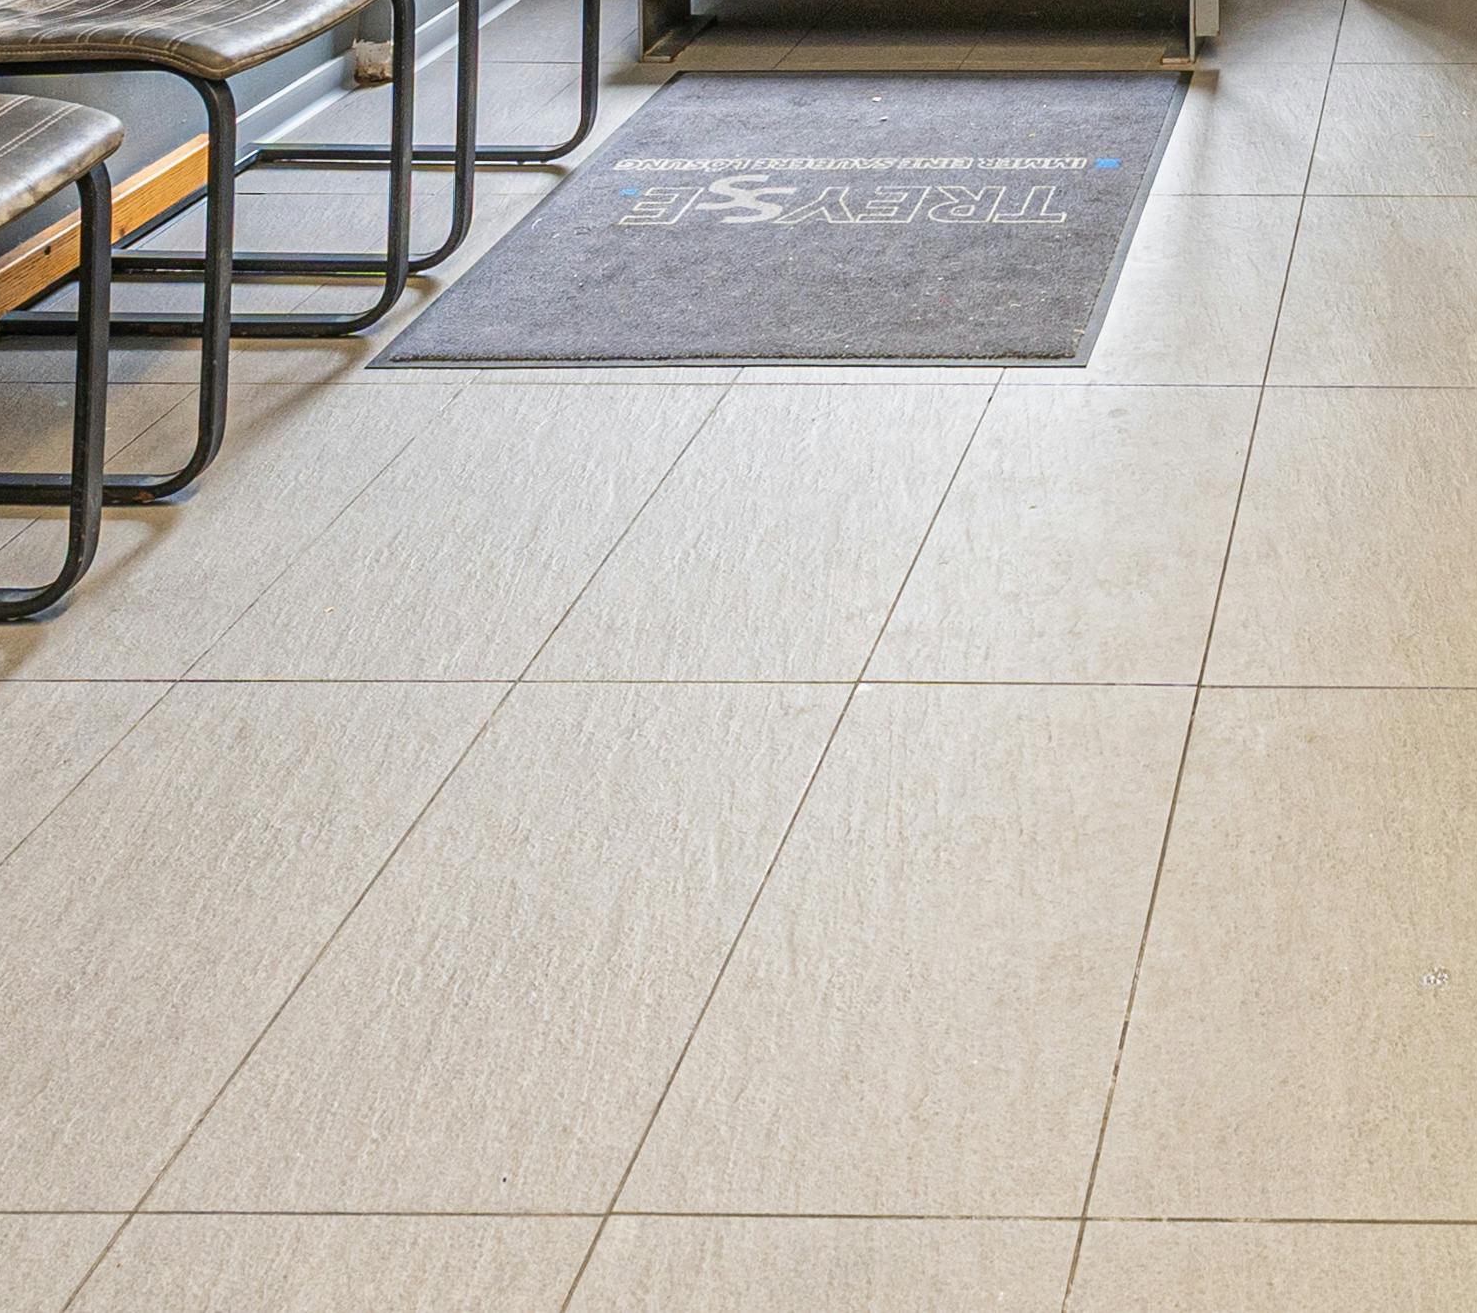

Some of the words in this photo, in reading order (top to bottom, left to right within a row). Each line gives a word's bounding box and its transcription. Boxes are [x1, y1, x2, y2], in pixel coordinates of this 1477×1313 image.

[612, 157, 751, 172] LÖSUNG
[751, 157, 897, 171] SAUBERE
[898, 157, 973, 170] EINE
[977, 157, 1087, 170] IMMER
